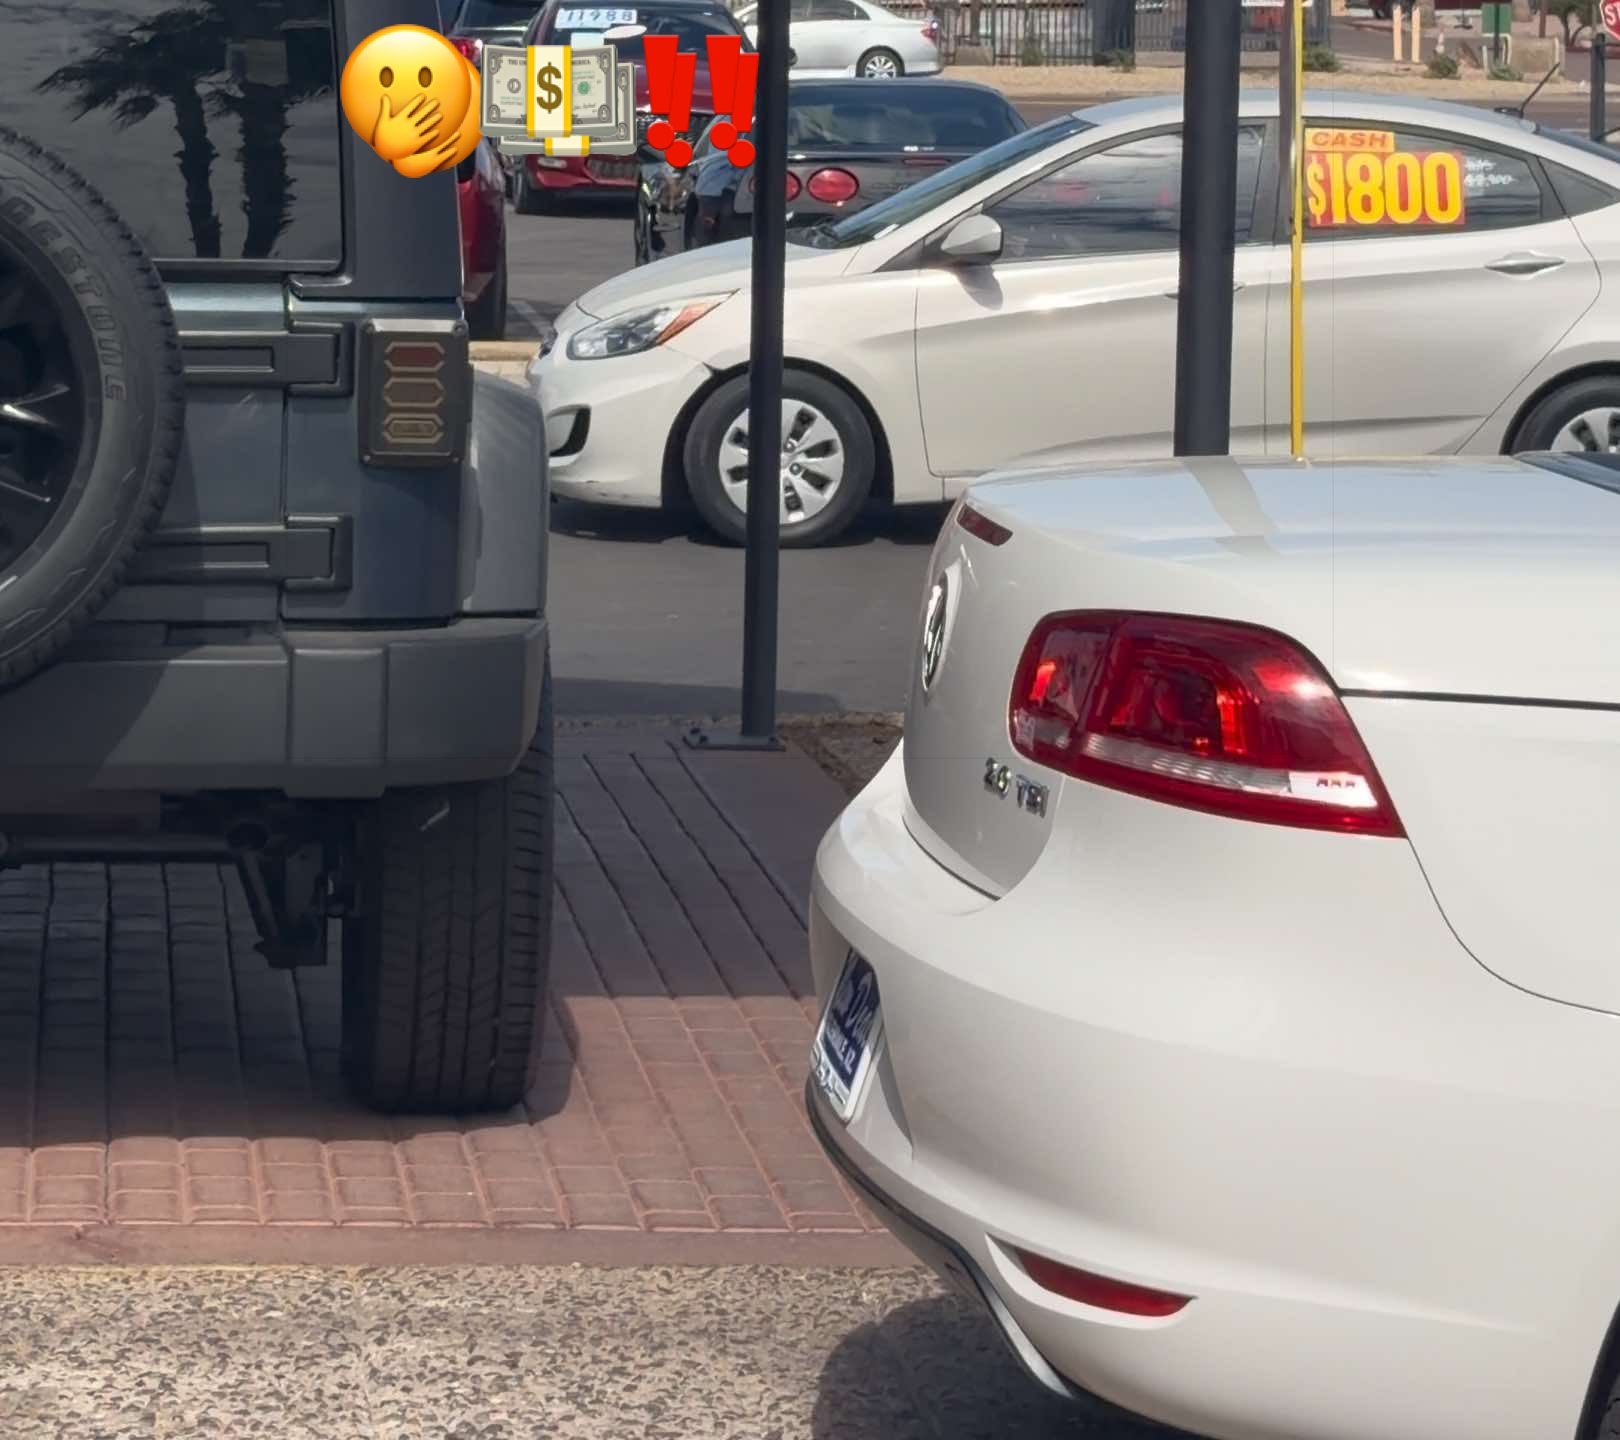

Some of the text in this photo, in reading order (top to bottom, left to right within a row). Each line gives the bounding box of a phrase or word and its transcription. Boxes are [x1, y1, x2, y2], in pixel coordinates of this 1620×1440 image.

[566, 10, 634, 22] 11988
[1311, 131, 1389, 148] CASH
[1306, 151, 1463, 225] $1800
[0, 188, 128, 402] GESTONE
